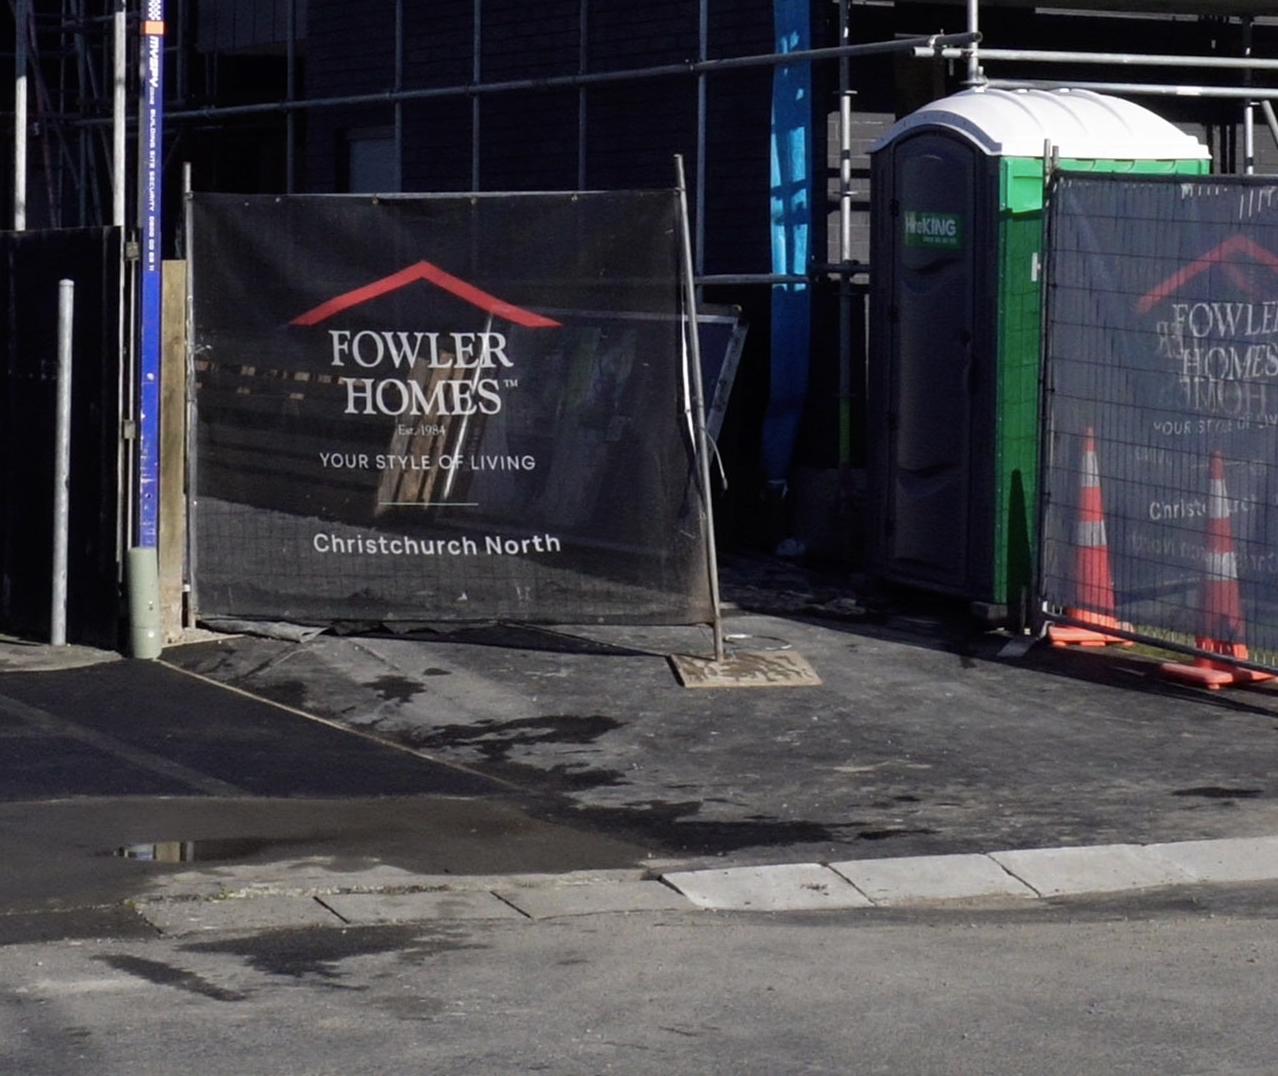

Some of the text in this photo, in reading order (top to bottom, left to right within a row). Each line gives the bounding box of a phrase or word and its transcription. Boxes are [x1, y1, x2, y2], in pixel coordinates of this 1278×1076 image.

[328, 330, 514, 369] FOWLER
[343, 377, 501, 416] HOMES
[421, 424, 445, 437] 1984
[319, 452, 536, 470] YOUR STYLE OF LIVING
[313, 533, 561, 556] Christchurch North
